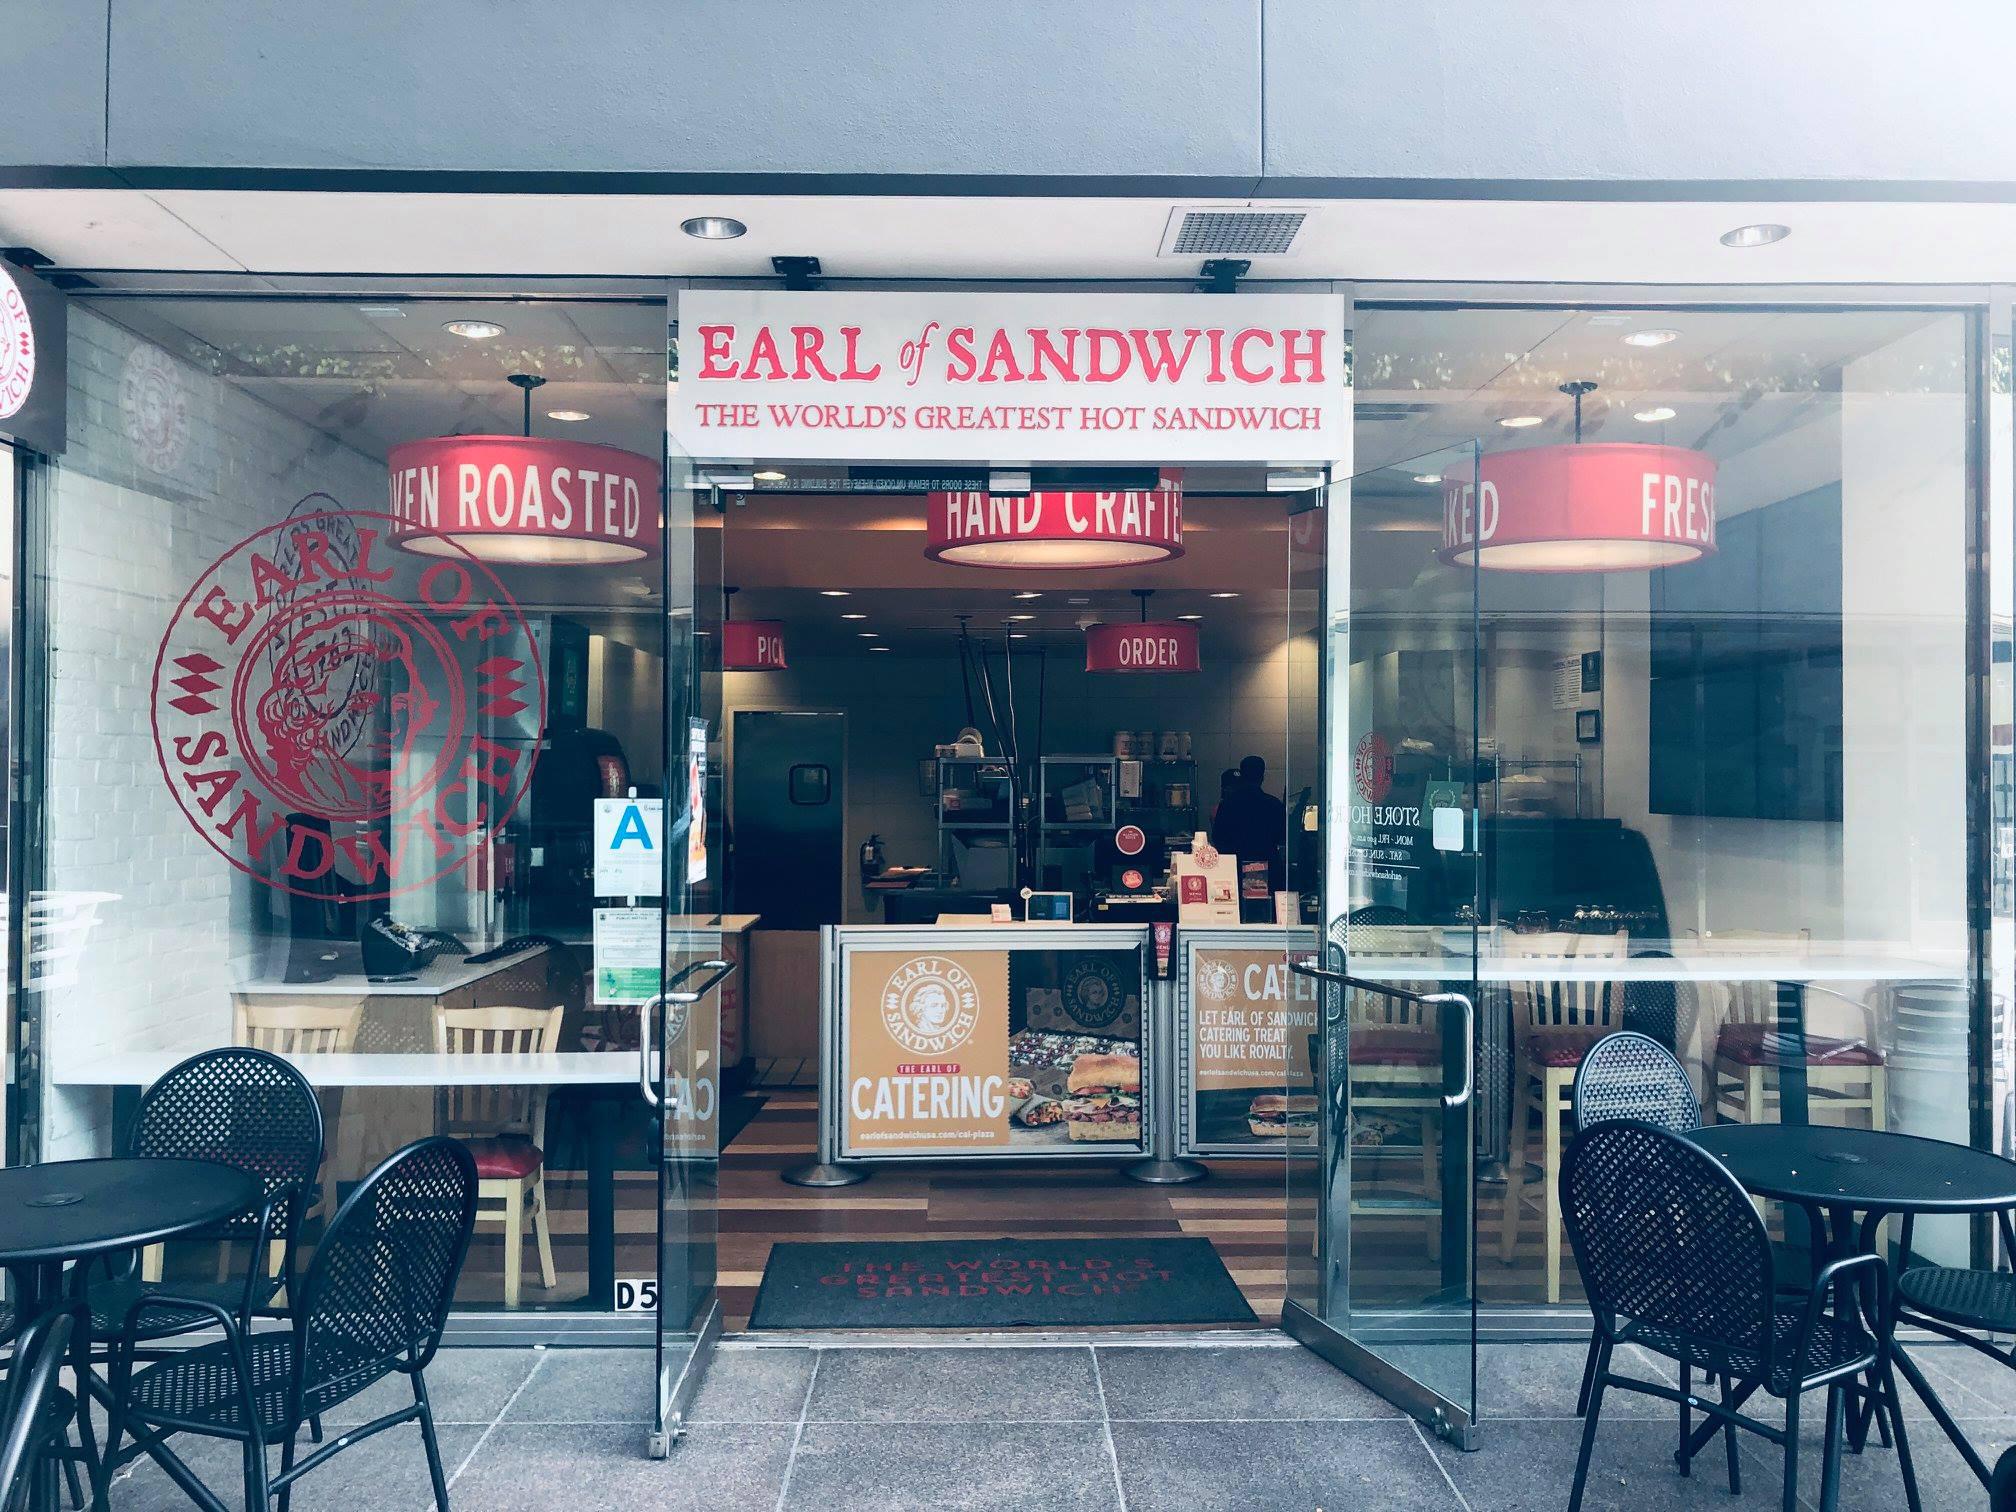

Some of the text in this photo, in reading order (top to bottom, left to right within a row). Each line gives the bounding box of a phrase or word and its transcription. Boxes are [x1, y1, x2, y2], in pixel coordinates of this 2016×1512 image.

[6, 288, 27, 324] OF
[698, 321, 1326, 386] EARL of SANDWICH
[695, 404, 1322, 430] THE WORLD'S GREATEST HOT SANDWICH
[389, 463, 640, 538] VEN ROASTED
[946, 478, 1183, 545] HAND CRAFTE
[1443, 480, 1500, 549] KED
[194, 528, 394, 645] EARL
[418, 561, 511, 641] OF
[1119, 637, 1178, 666] ORDER
[173, 730, 522, 885] SANDWICH
[610, 805, 653, 849] A
[891, 960, 971, 992] EARL OF
[887, 1012, 974, 1052] SANDWICH
[1199, 1010, 1217, 1026] LET
[1221, 1010, 1247, 1026] EARL
[1250, 1010, 1264, 1026] OF
[1199, 1027, 1286, 1043] CATERING TREAT
[1199, 1043, 1223, 1059] YOU
[1224, 1044, 1247, 1059] LIKE
[899, 1064, 959, 1074] THE EARL OF
[851, 1075, 1005, 1120] CATERING
[860, 1129, 995, 1142] earlofsandwichusa.com/cal-plaza
[818, 1269, 1172, 1286] GREATEST HOT
[838, 1261, 923, 1274] THE
